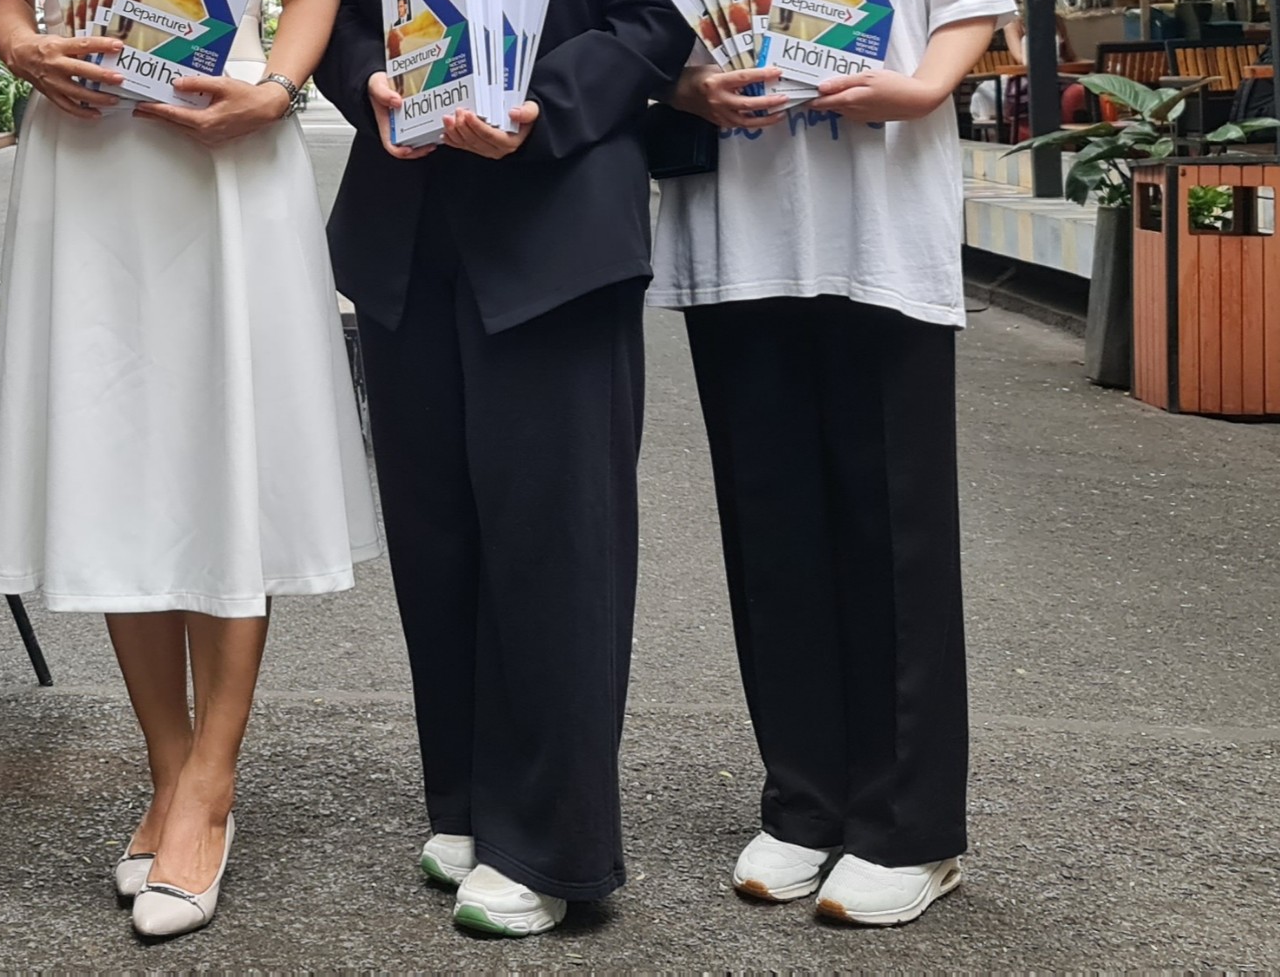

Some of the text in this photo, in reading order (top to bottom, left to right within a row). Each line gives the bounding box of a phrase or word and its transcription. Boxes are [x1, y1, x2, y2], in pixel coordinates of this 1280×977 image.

[122, 0, 188, 33] Departure
[392, 46, 437, 72] Departure
[433, 81, 470, 109] hành
